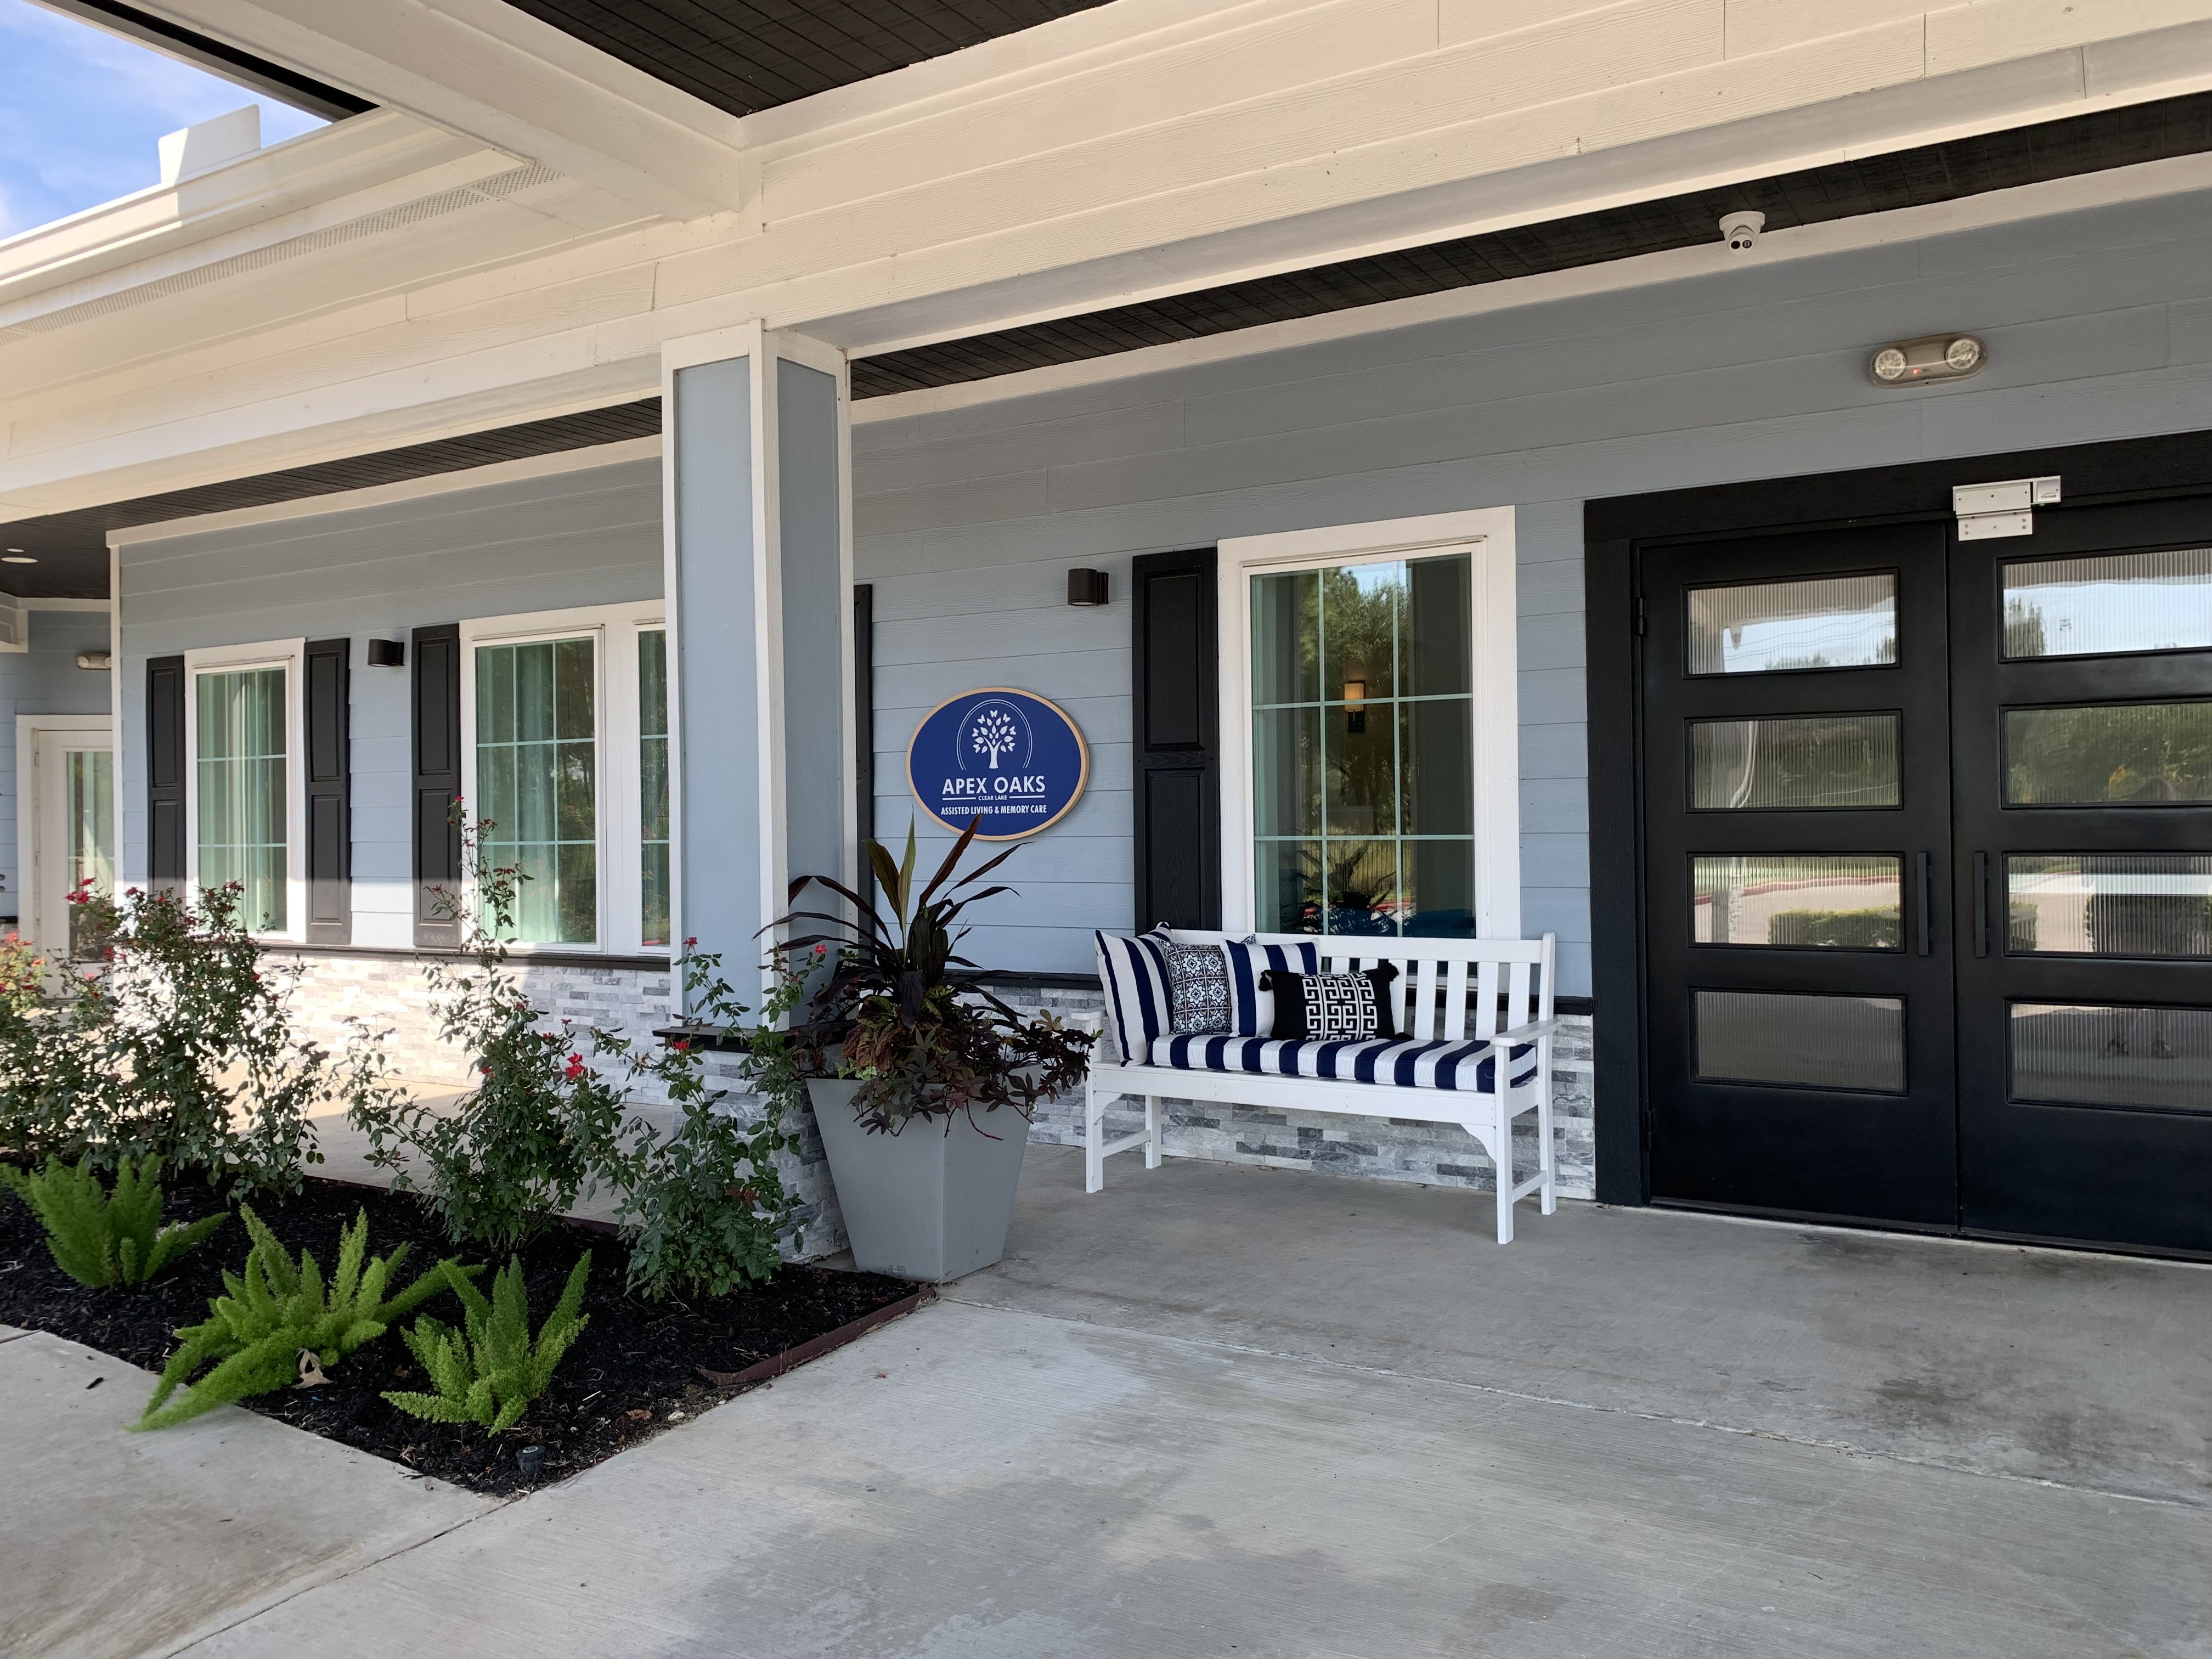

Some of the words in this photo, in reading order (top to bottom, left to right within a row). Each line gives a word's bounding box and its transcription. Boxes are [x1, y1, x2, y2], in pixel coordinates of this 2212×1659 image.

[942, 777, 987, 795] APEX
[994, 775, 1046, 793] OAKS
[941, 806, 969, 815] ASSISTED
[970, 805, 993, 815] LIVING
[994, 806, 1000, 814] &
[1001, 805, 1029, 814] MEMORY
[1030, 804, 1047, 813] CARE
